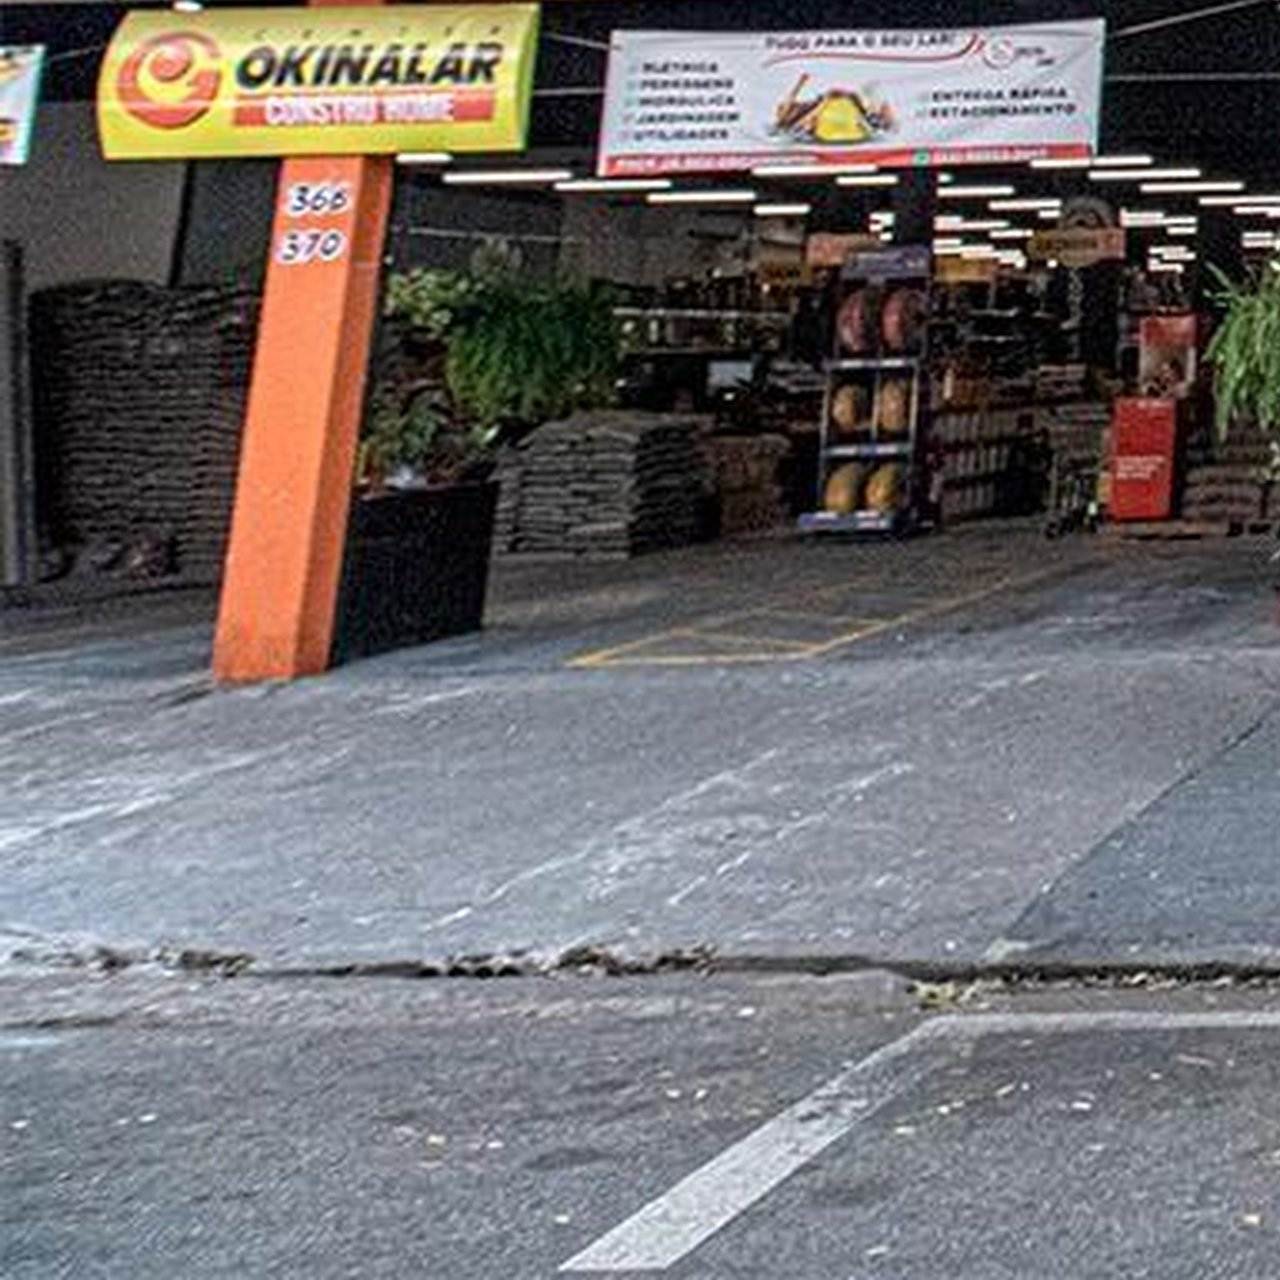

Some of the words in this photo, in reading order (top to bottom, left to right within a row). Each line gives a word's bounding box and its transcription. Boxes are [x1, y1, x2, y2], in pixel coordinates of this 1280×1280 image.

[814, 35, 857, 47] PARA
[235, 42, 503, 89] OKINALAR
[292, 185, 347, 212] 366
[282, 232, 341, 261] 370
